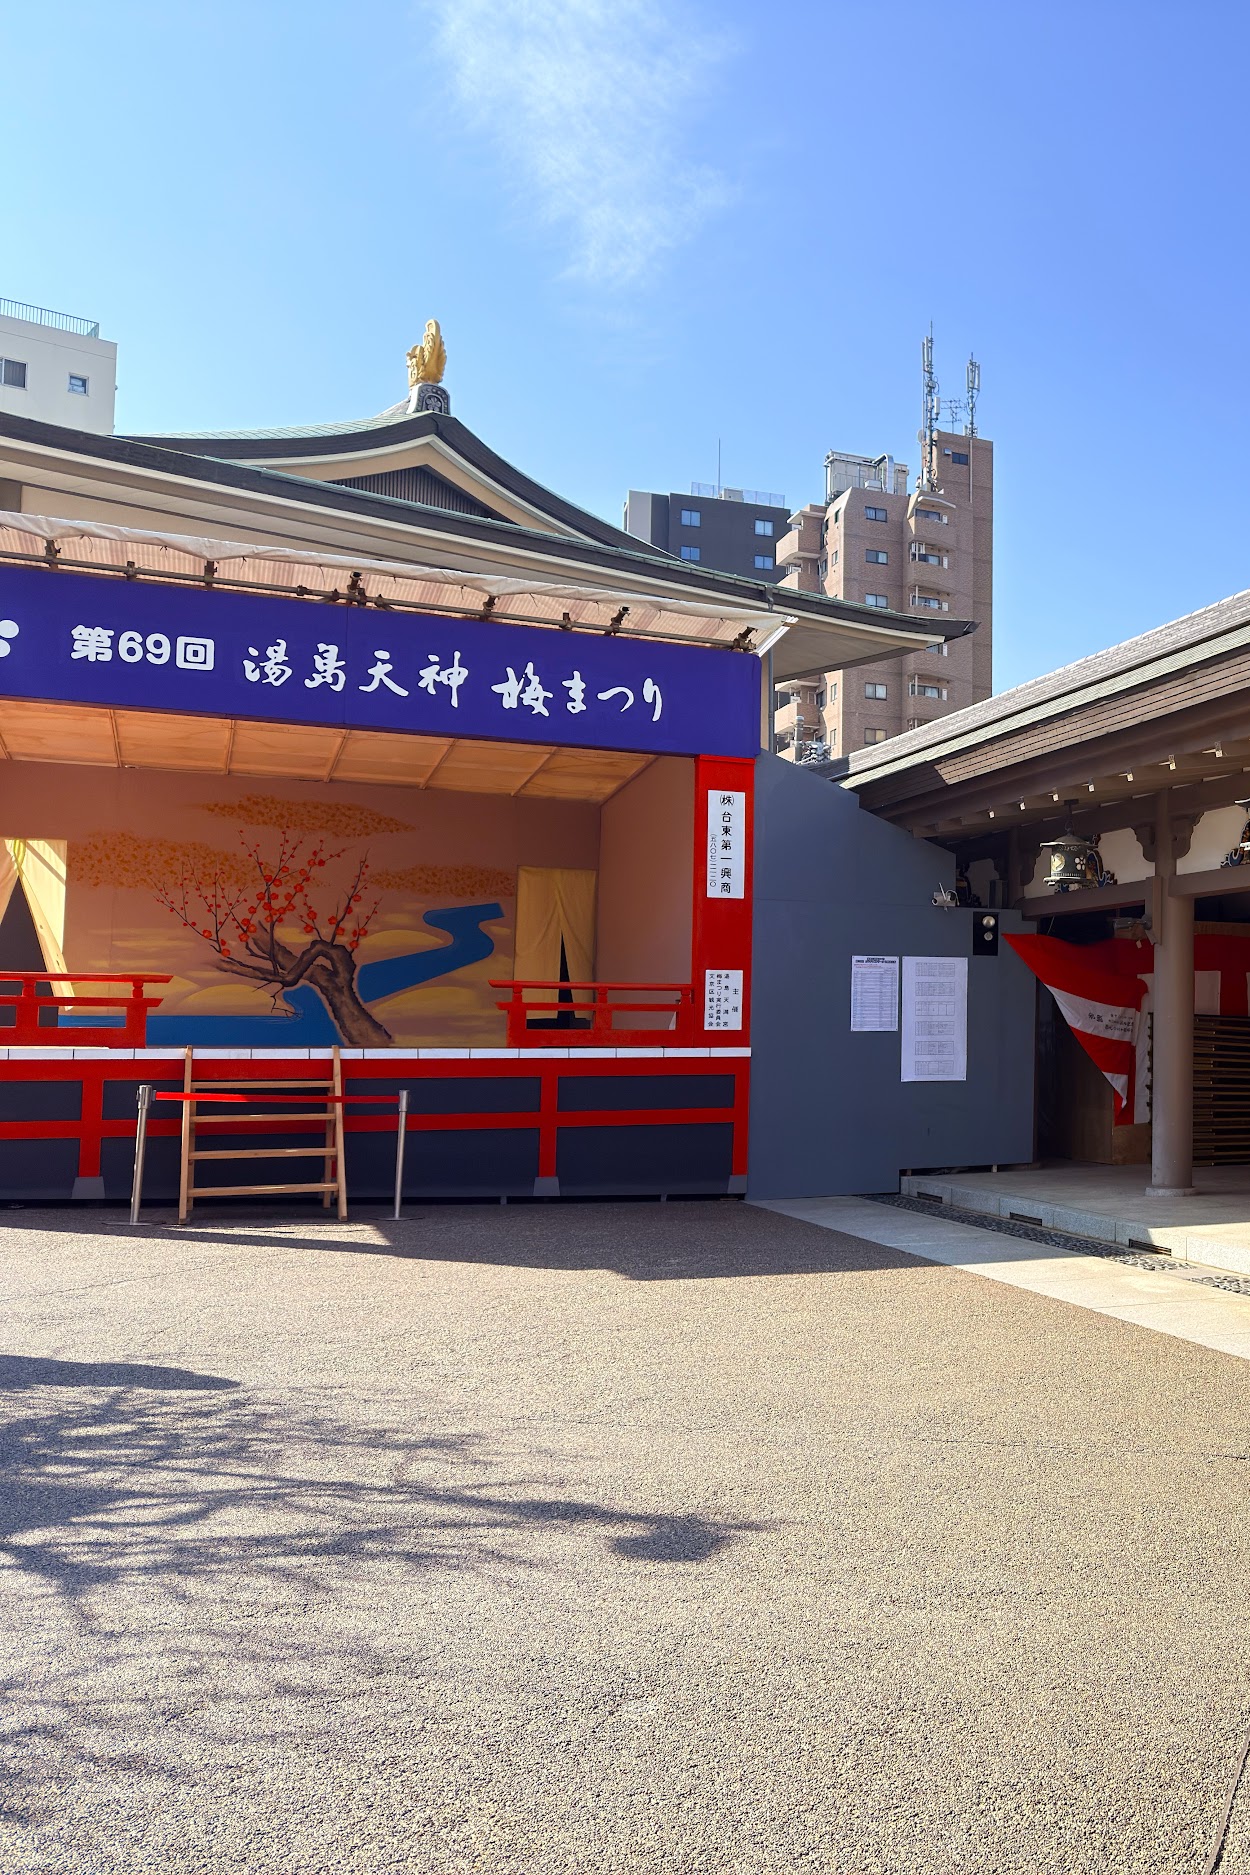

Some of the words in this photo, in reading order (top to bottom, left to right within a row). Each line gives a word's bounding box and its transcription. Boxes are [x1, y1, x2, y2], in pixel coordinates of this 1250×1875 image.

[71, 624, 215, 671] 第69回
[242, 638, 470, 708] 湯島天神
[490, 661, 663, 722] 梅まつり
